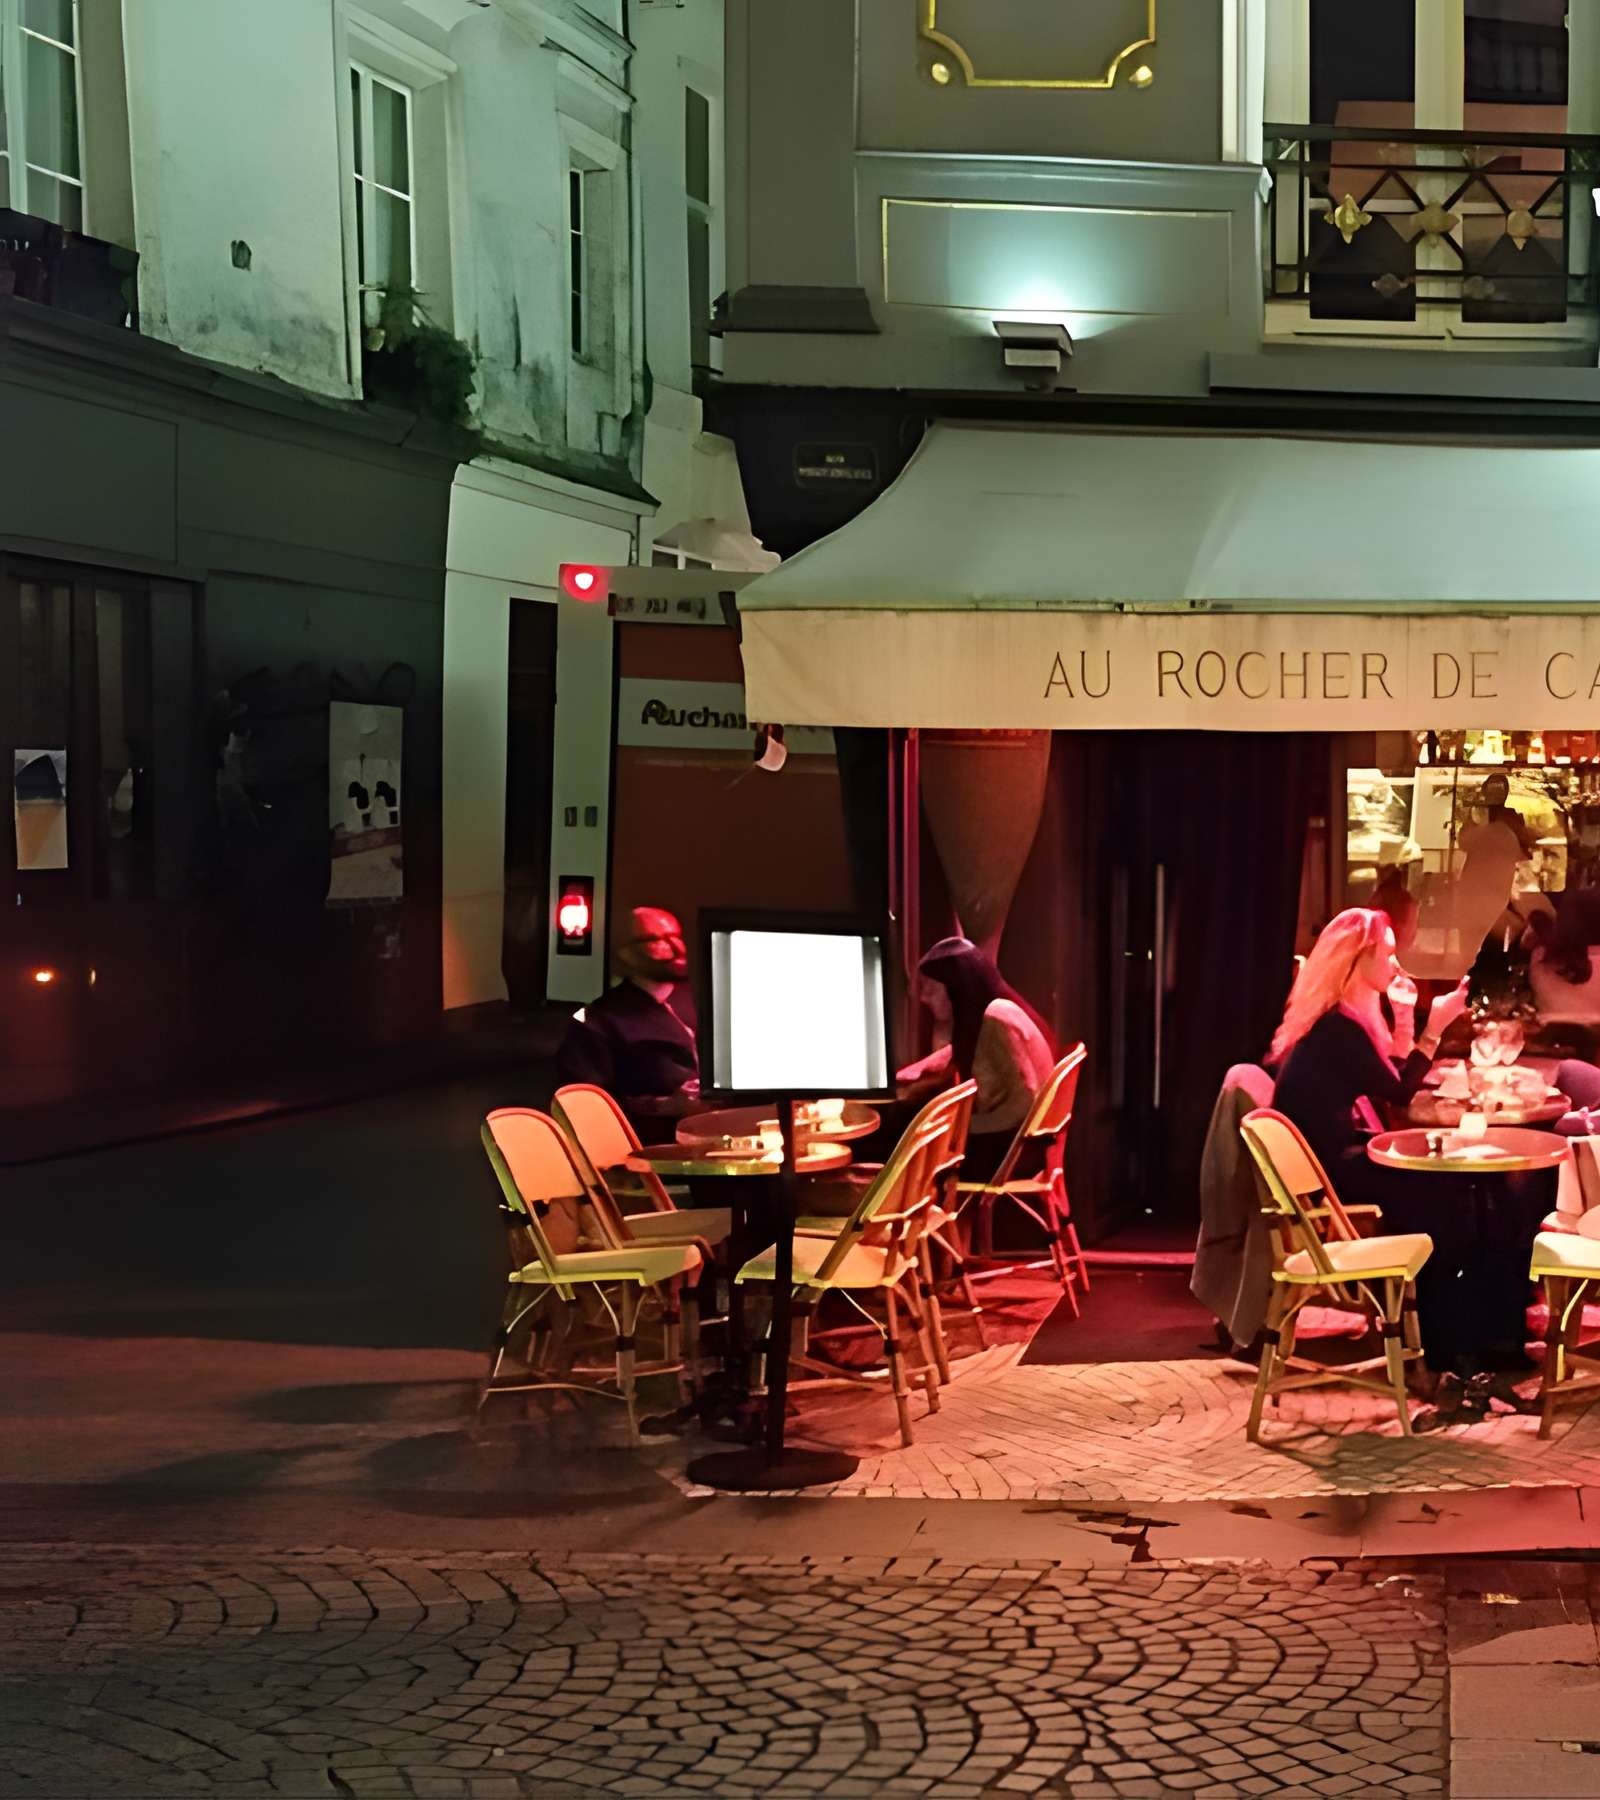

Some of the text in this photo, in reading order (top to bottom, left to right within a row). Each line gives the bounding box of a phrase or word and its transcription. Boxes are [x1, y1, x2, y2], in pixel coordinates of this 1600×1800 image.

[1044, 650, 1111, 698] AU
[1157, 650, 1393, 699] ROCHER
[1431, 650, 1499, 699] DE
